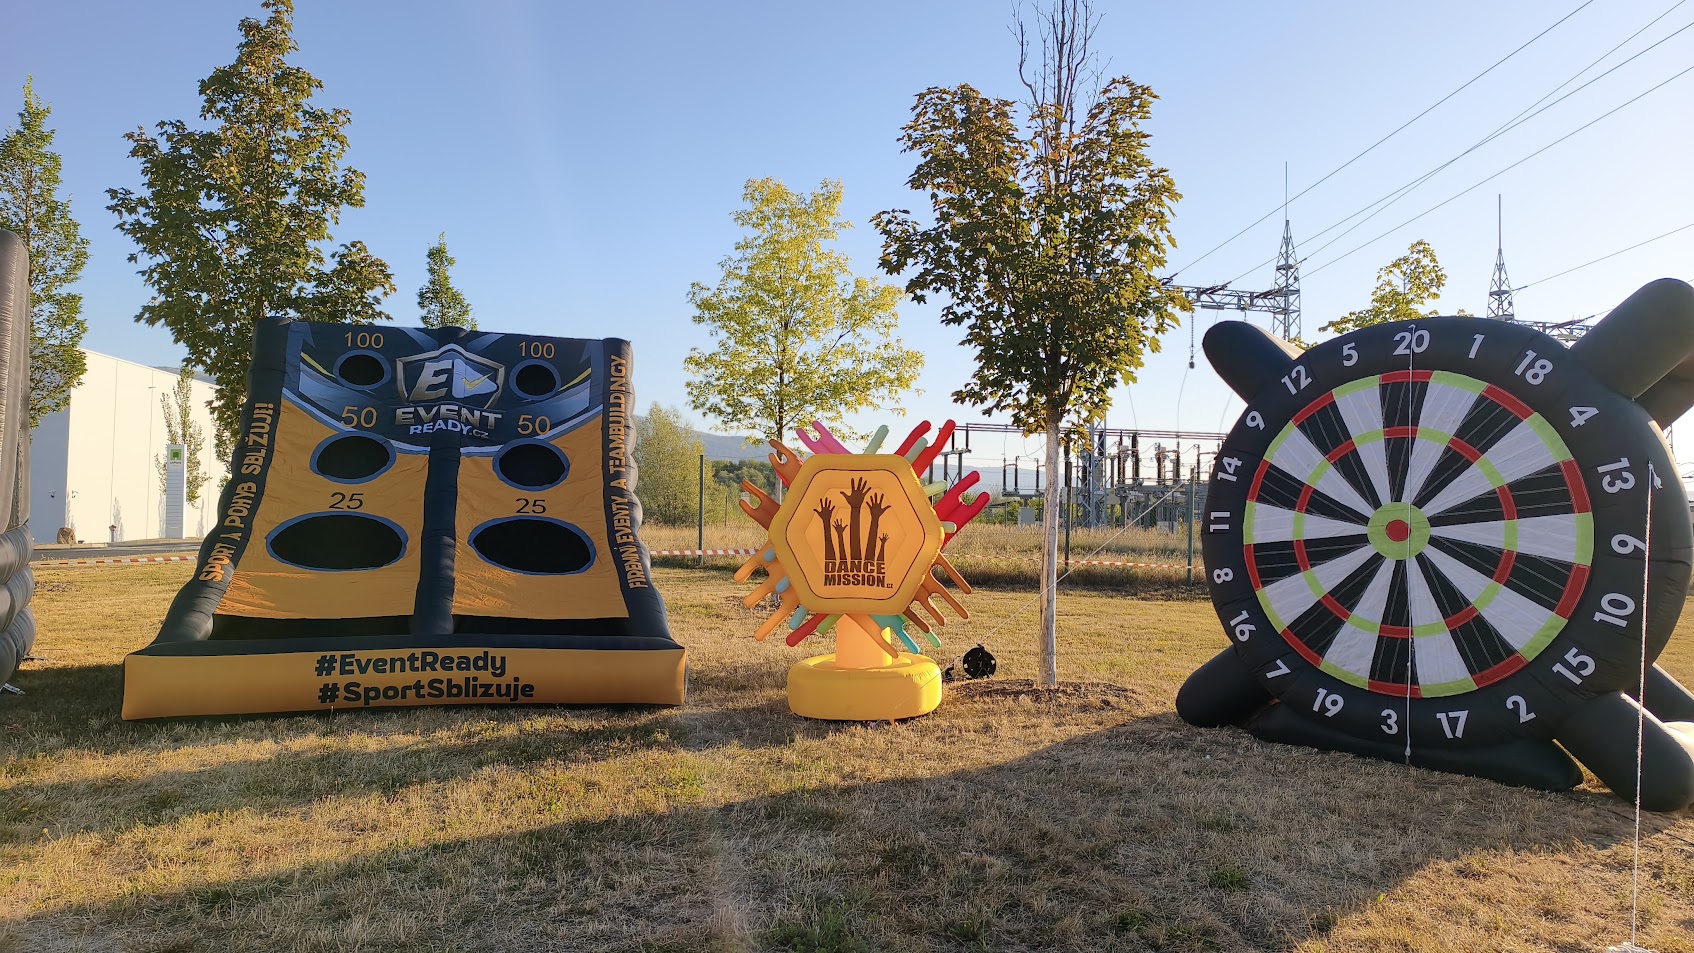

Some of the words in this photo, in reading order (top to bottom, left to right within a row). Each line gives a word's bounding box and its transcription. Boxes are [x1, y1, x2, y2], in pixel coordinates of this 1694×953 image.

[344, 331, 385, 349] 100
[518, 341, 555, 359] 100
[1392, 329, 1430, 356] 20
[1468, 333, 1485, 359] 1
[1342, 342, 1359, 367] 5
[1514, 349, 1554, 386] 18
[1281, 364, 1313, 396] 12
[340, 405, 378, 428] 50
[395, 404, 503, 430] EVENT
[517, 414, 551, 436] 50
[608, 354, 627, 475] TEAMBUILDINGY
[1245, 410, 1266, 431] 9
[1568, 406, 1600, 428] 4
[1217, 456, 1243, 482] 14
[1596, 457, 1636, 493] 13
[610, 478, 628, 490] A
[223, 481, 258, 529] POHYB
[328, 492, 364, 510] 25
[515, 498, 547, 514] 25
[610, 495, 635, 551] EVENTY
[1209, 511, 1231, 533] 11
[219, 532, 243, 541] A
[198, 542, 238, 583] SPORT
[824, 560, 886, 575] DANCE
[1213, 567, 1234, 584] 8
[1593, 592, 1636, 628] 10
[1229, 610, 1257, 642] 16
[314, 650, 507, 678] #EventReady
[1265, 658, 1292, 679] 7
[1551, 646, 1596, 686] 15
[317, 676, 535, 706] #SportSblizuje
[1312, 687, 1345, 718] 19
[1380, 708, 1399, 735] 3
[1505, 694, 1537, 724] 2
[1436, 710, 1469, 739] 17
